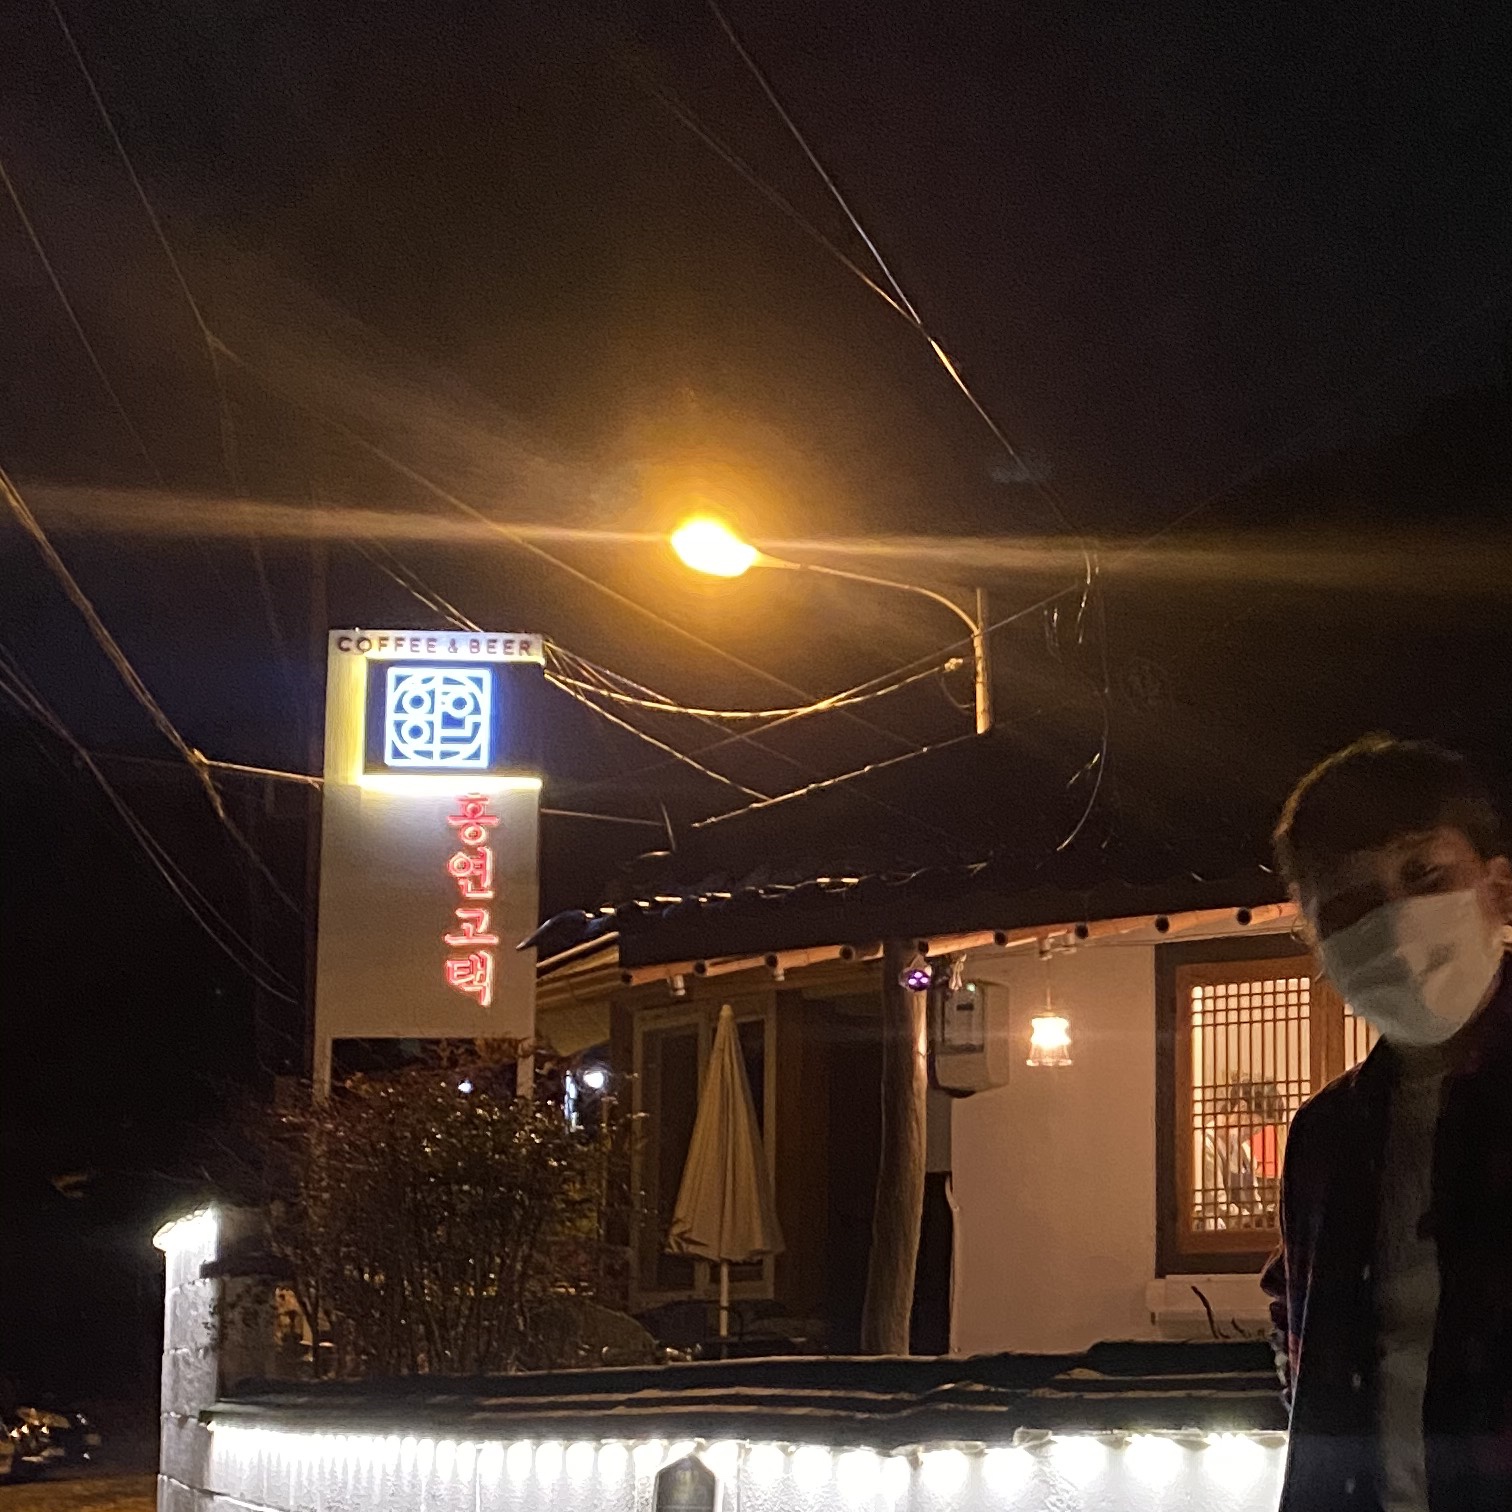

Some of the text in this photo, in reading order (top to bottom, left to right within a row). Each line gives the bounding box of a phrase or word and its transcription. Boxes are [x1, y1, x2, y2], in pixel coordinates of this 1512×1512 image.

[337, 636, 533, 656] COFFEE & BEER
[445, 792, 500, 1006] 홍연고택
